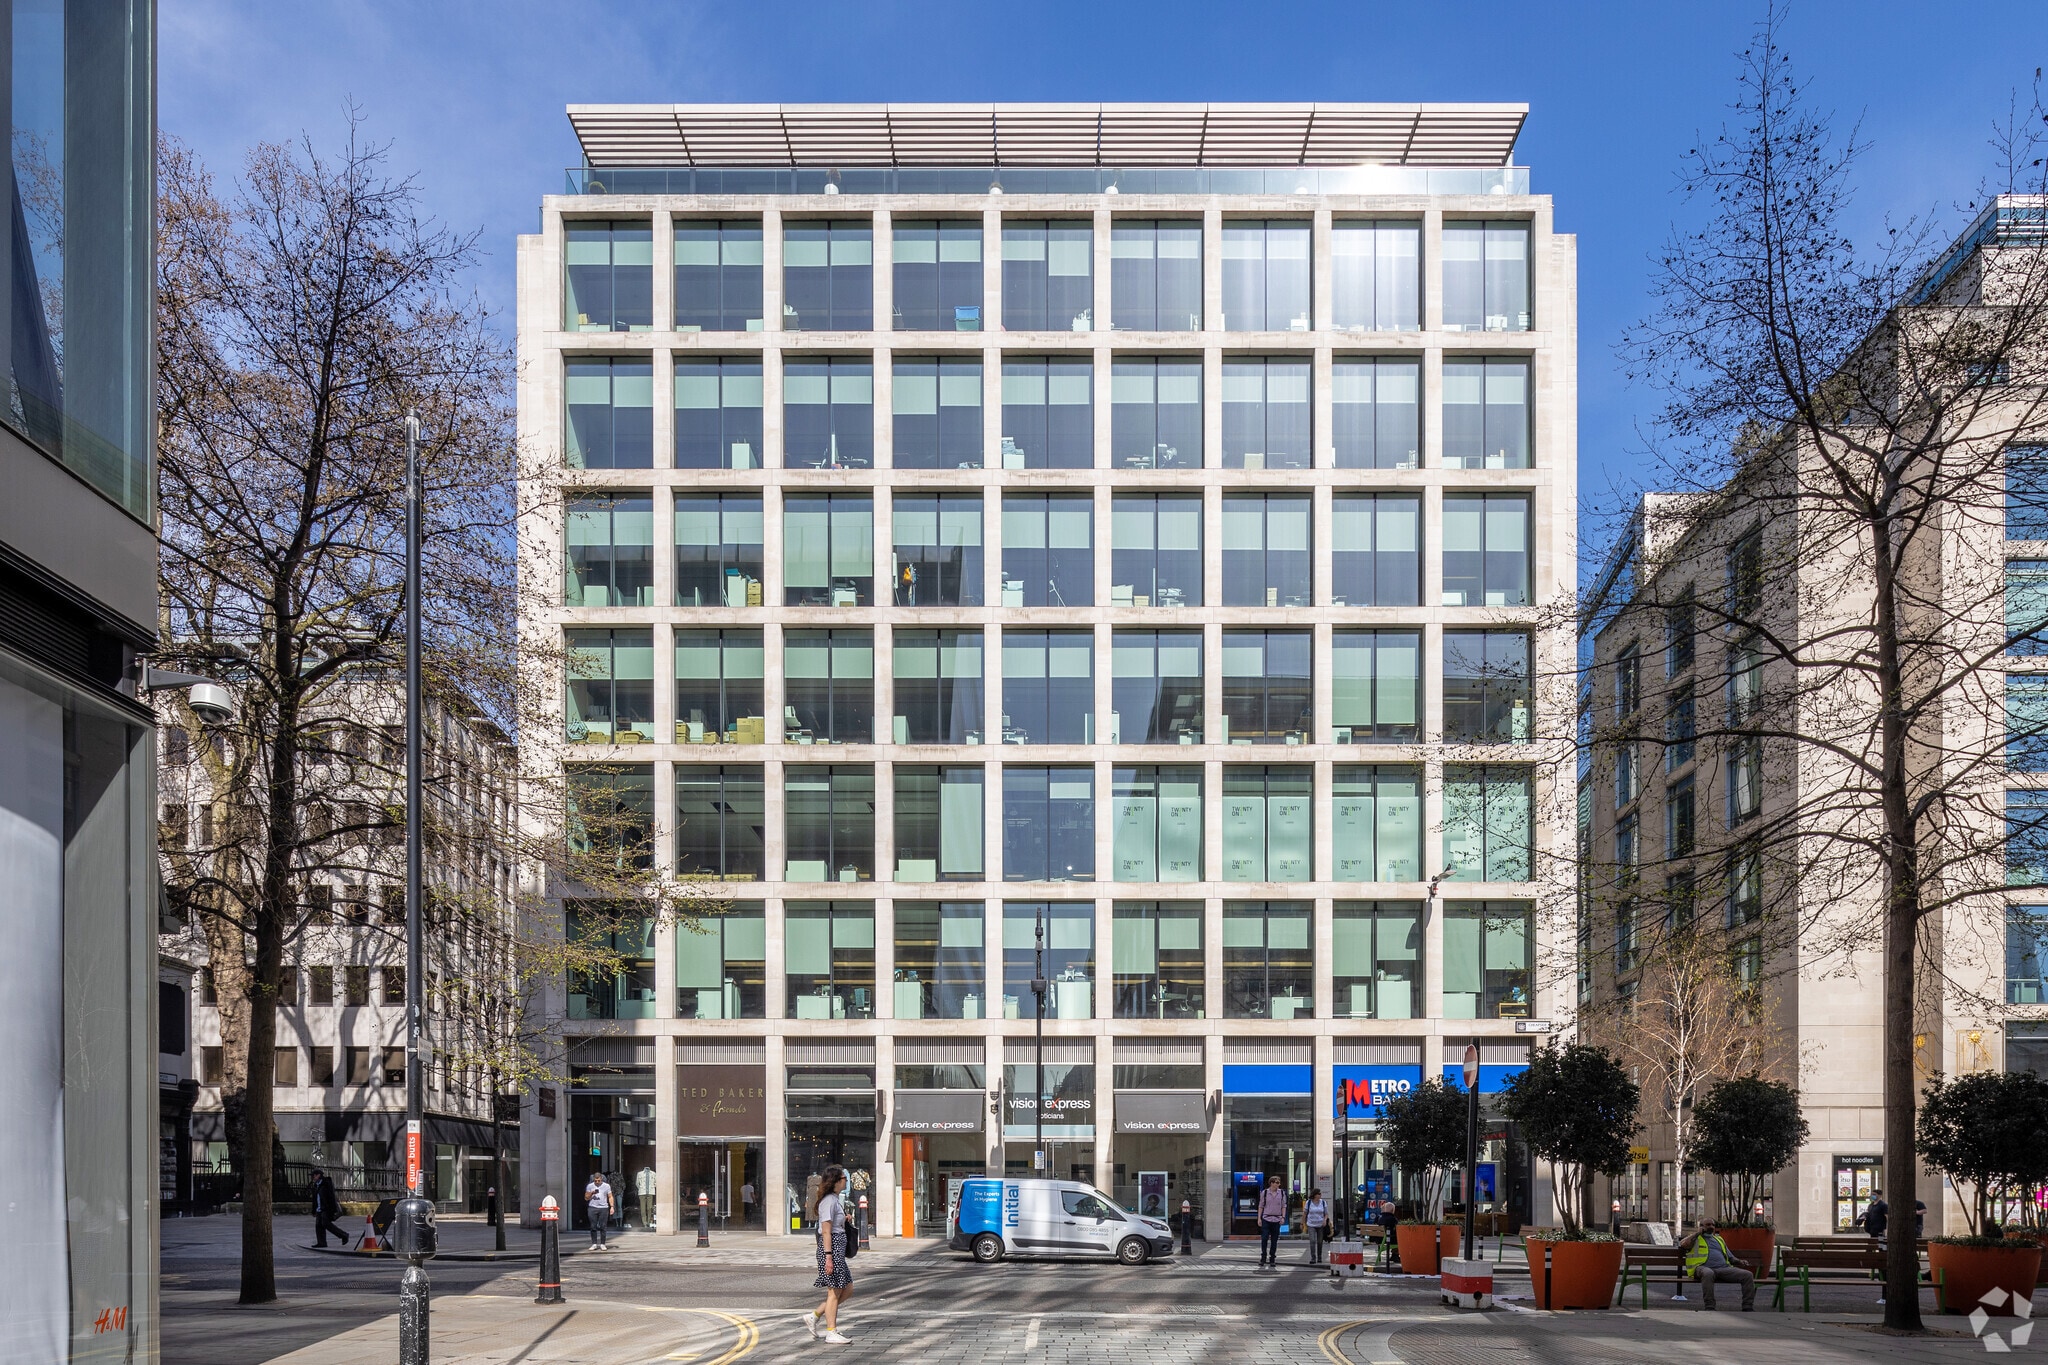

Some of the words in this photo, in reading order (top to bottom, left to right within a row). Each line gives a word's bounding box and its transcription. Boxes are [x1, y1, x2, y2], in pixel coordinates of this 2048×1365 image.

[682, 1088, 707, 1097] TED
[720, 1088, 764, 1097] BAKER
[712, 1100, 746, 1117] friends
[1045, 1098, 1091, 1110] express
[932, 1122, 974, 1130] express
[1157, 1122, 1200, 1130] express
[1005, 1185, 1019, 1227] Initial
[94, 1306, 128, 1334] H&M
